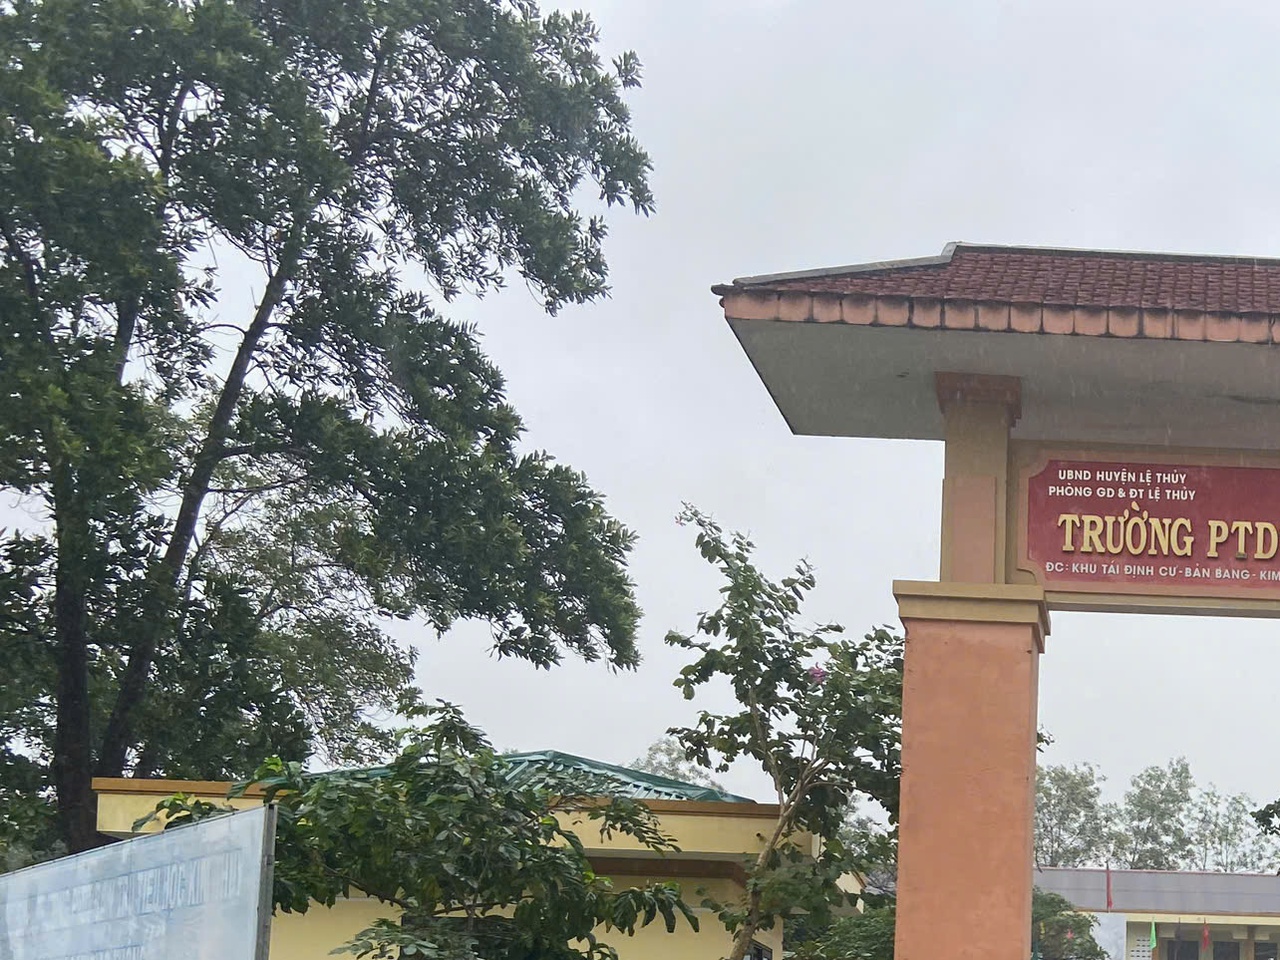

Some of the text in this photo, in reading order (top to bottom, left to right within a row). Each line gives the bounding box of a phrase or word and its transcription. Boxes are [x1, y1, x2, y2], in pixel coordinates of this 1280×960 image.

[1058, 468, 1187, 486] UBND HUYỆN LỆ THỦY
[1048, 482, 1196, 502] PHÒNG GD & ĐT LỆ THỦY
[1057, 501, 1195, 557] TRƯỜNG
[1045, 561, 1069, 573] ĐC:
[1071, 562, 1098, 574] KHU
[1101, 560, 1120, 575] TÁI
[1124, 565, 1154, 578] ĐỊNH
